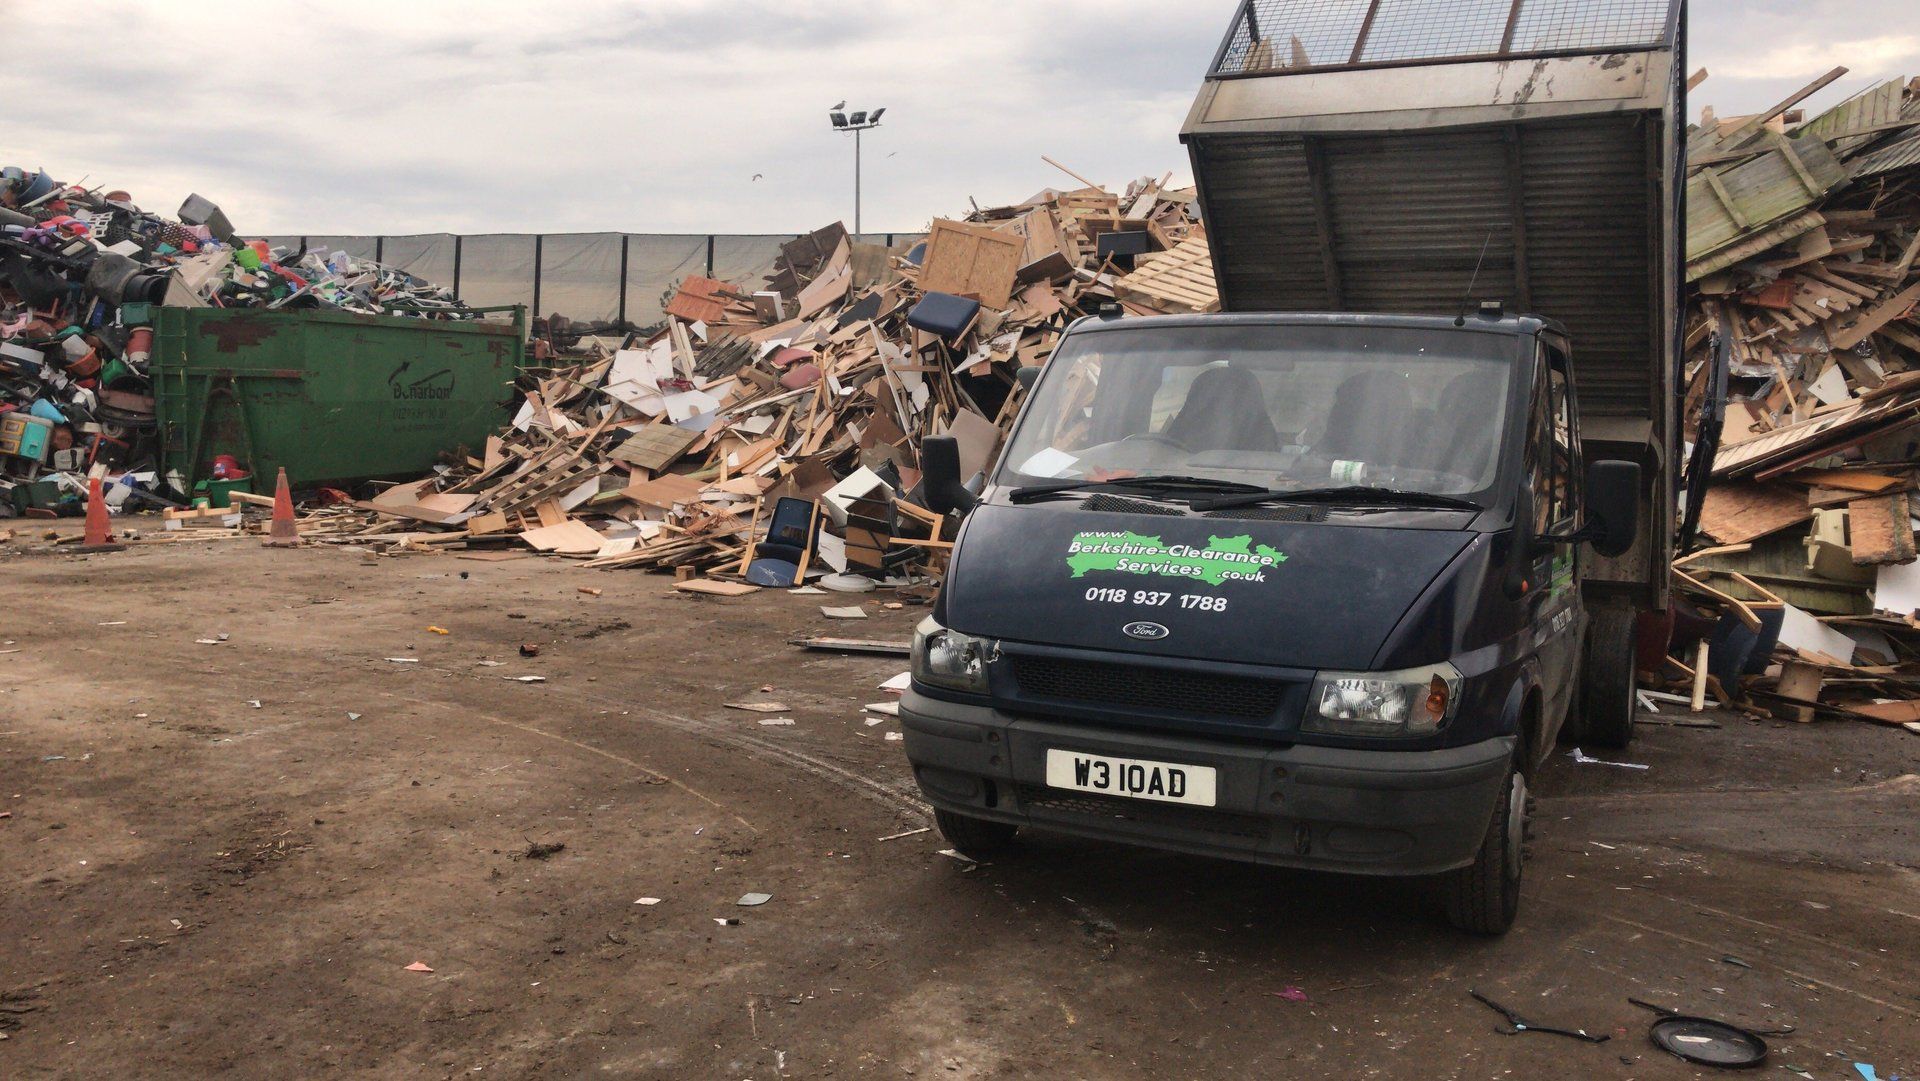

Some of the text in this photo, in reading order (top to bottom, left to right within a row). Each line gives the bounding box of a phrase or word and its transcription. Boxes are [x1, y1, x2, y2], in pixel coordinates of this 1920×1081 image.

[1068, 541, 1274, 566] Berkshire-Clearance
[1115, 558, 1266, 583] Services .co.uk
[1085, 587, 1228, 612] 0118 937 1788
[1132, 624, 1158, 637] Ford
